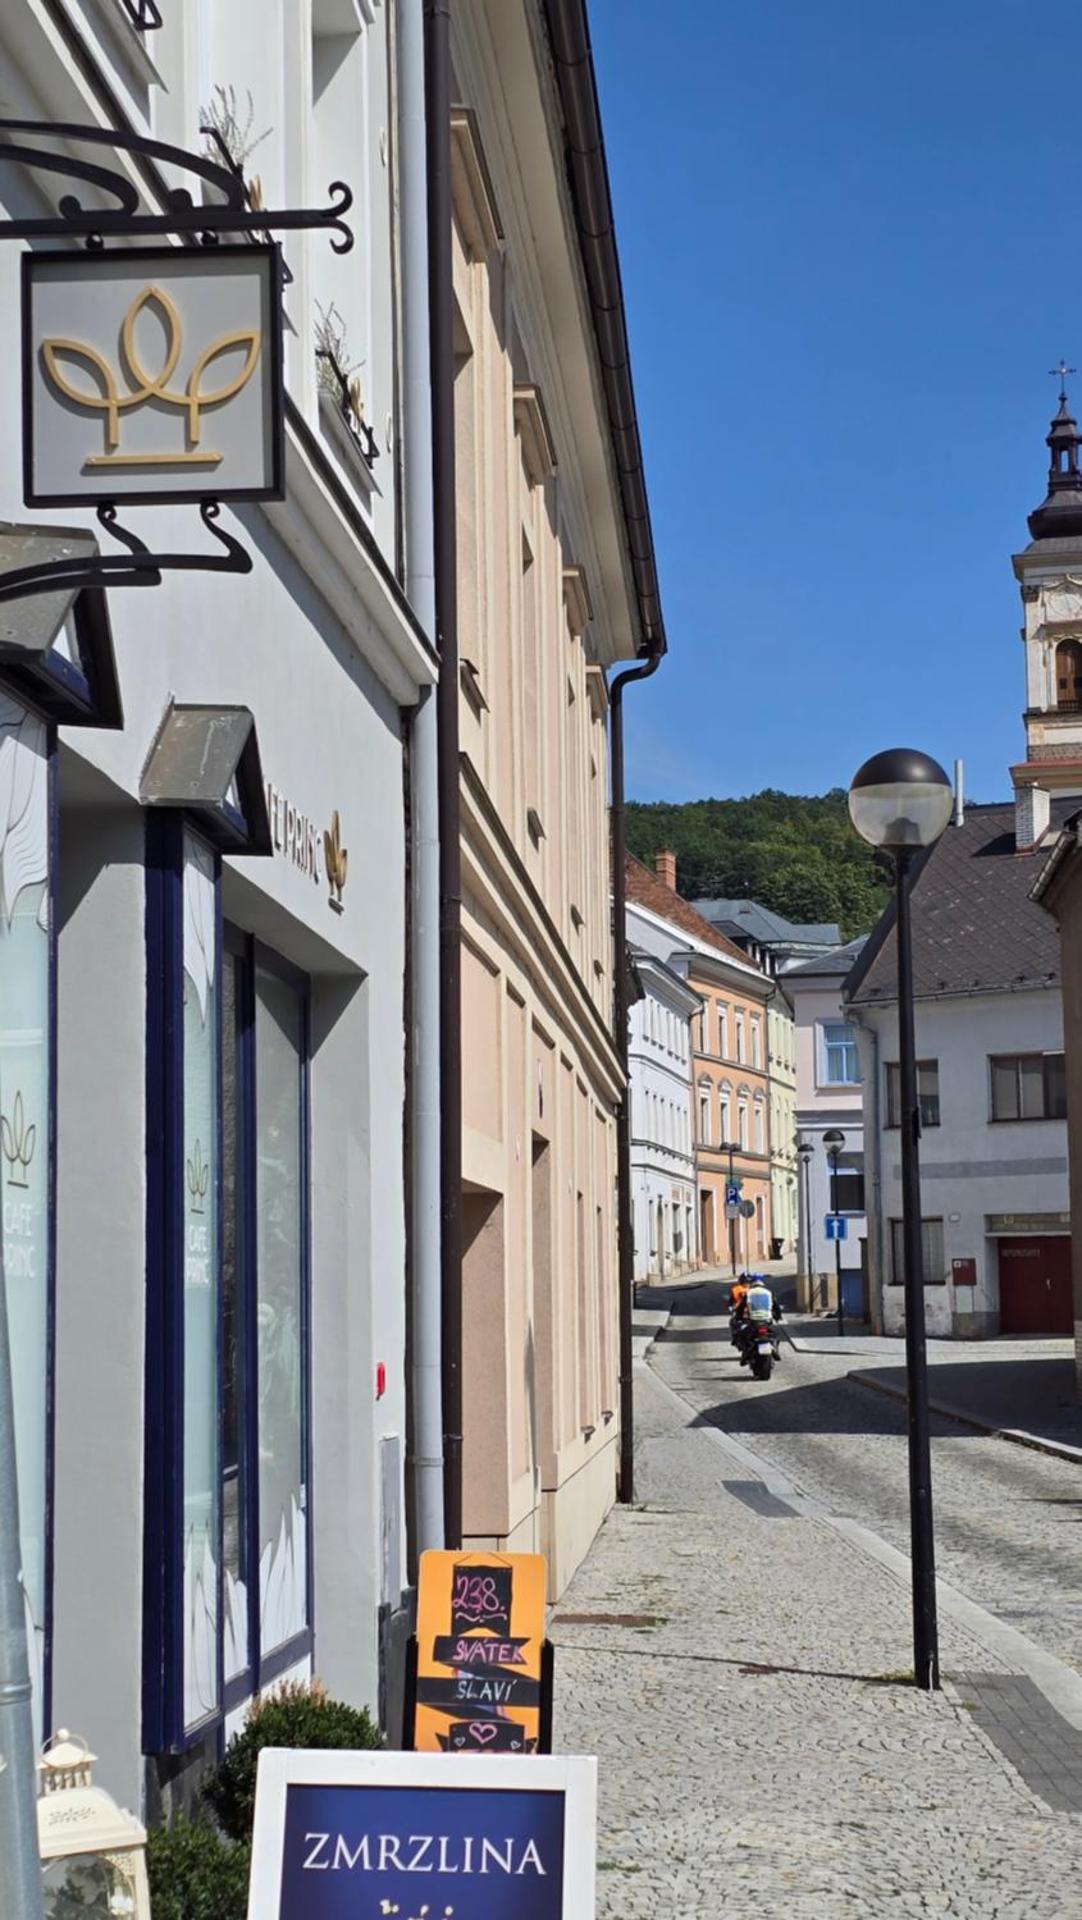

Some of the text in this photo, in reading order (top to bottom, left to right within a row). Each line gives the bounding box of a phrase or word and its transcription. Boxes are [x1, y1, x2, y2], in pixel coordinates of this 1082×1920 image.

[727, 1188, 736, 1200] P
[452, 1638, 522, 1663] SVÁTEK
[455, 1679, 518, 1702] SLAVÍ
[302, 1832, 547, 1875] ZMRZLINA
